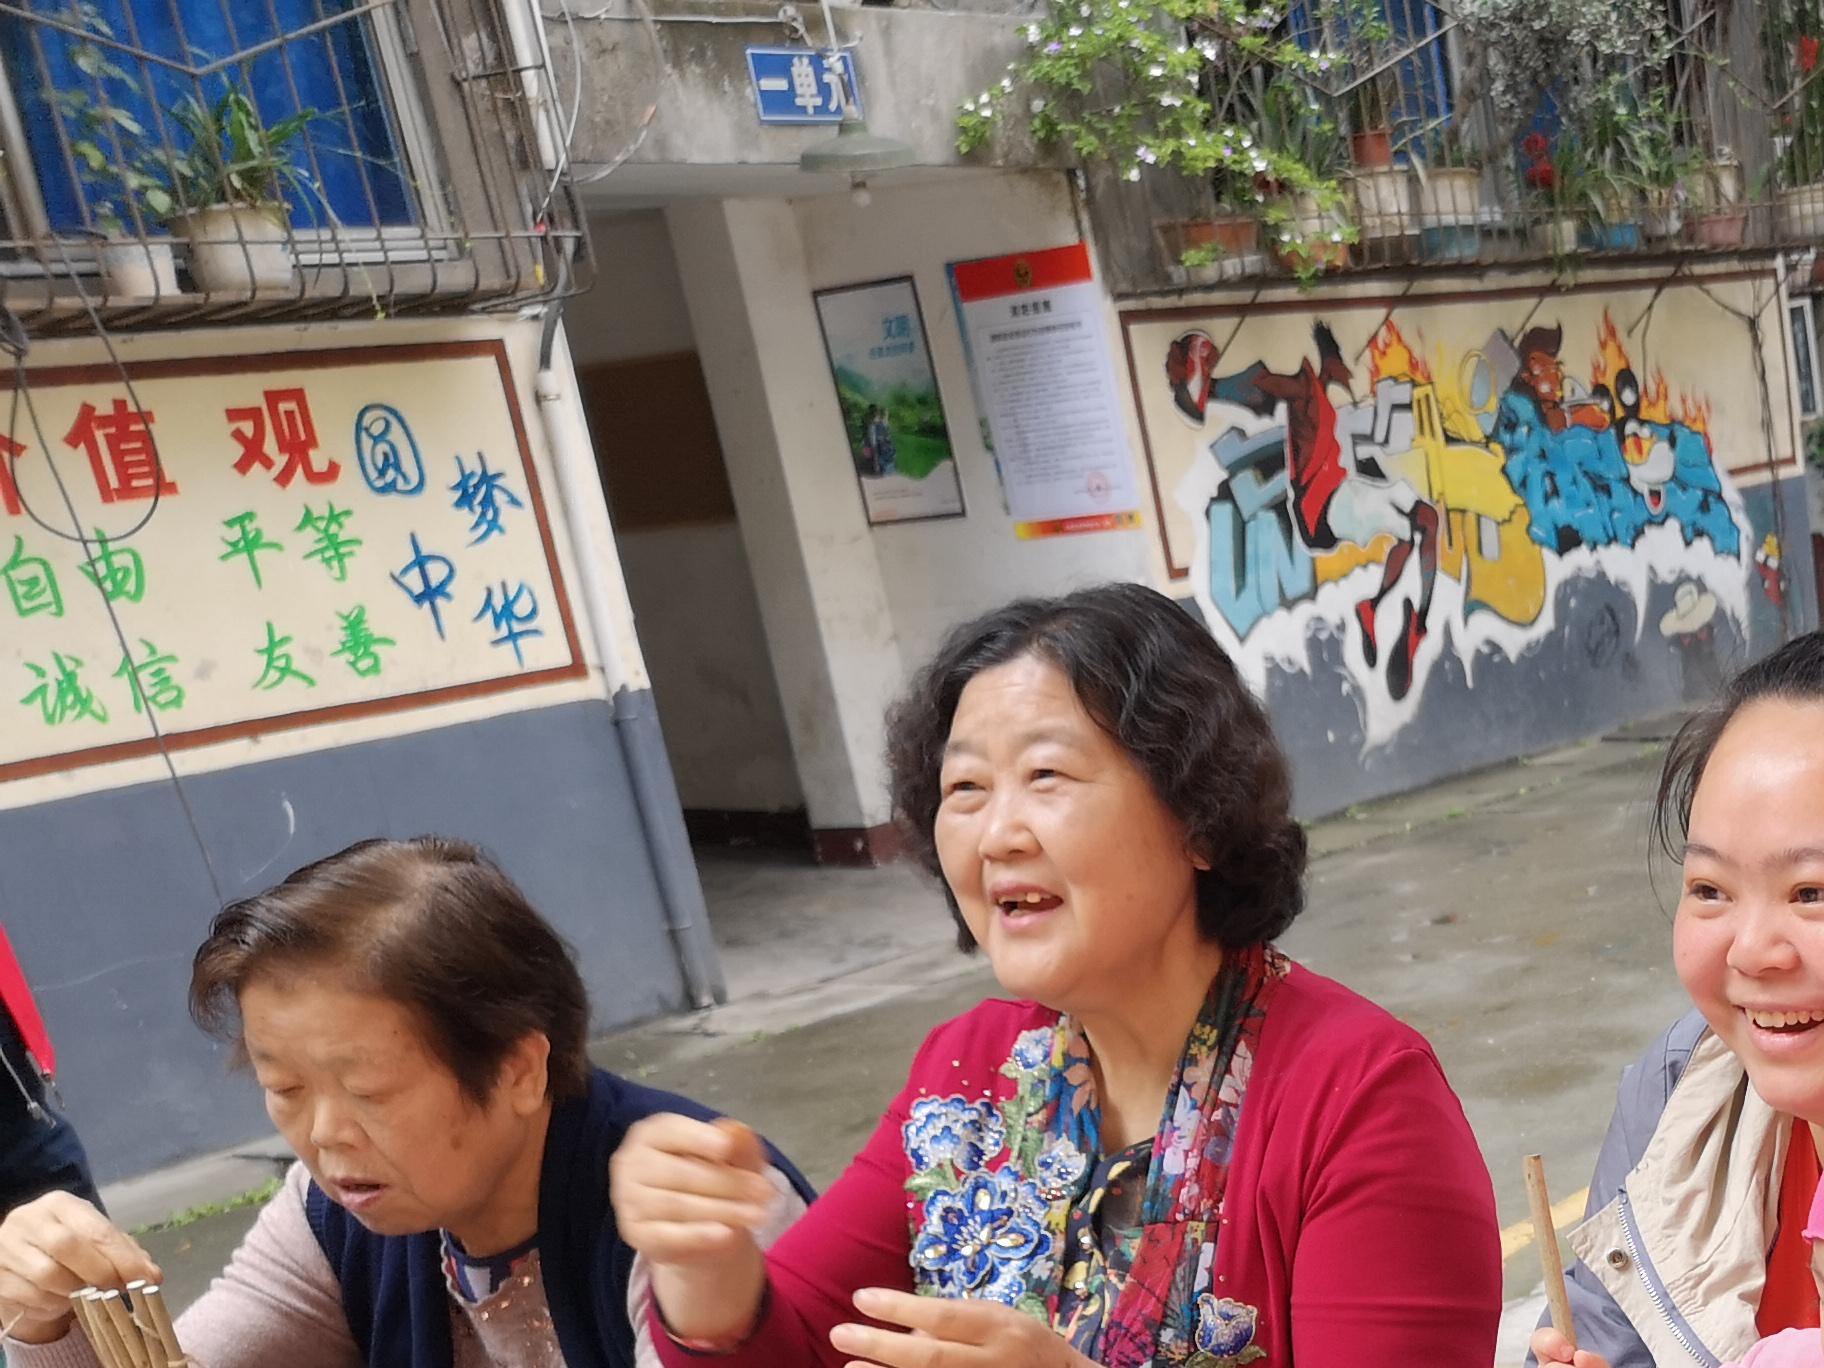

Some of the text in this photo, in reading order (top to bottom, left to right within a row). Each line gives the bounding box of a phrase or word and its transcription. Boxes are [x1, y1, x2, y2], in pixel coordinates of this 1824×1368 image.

[0, 500, 364, 618] 自由 平等
[20, 603, 397, 726] 诚信 友善
